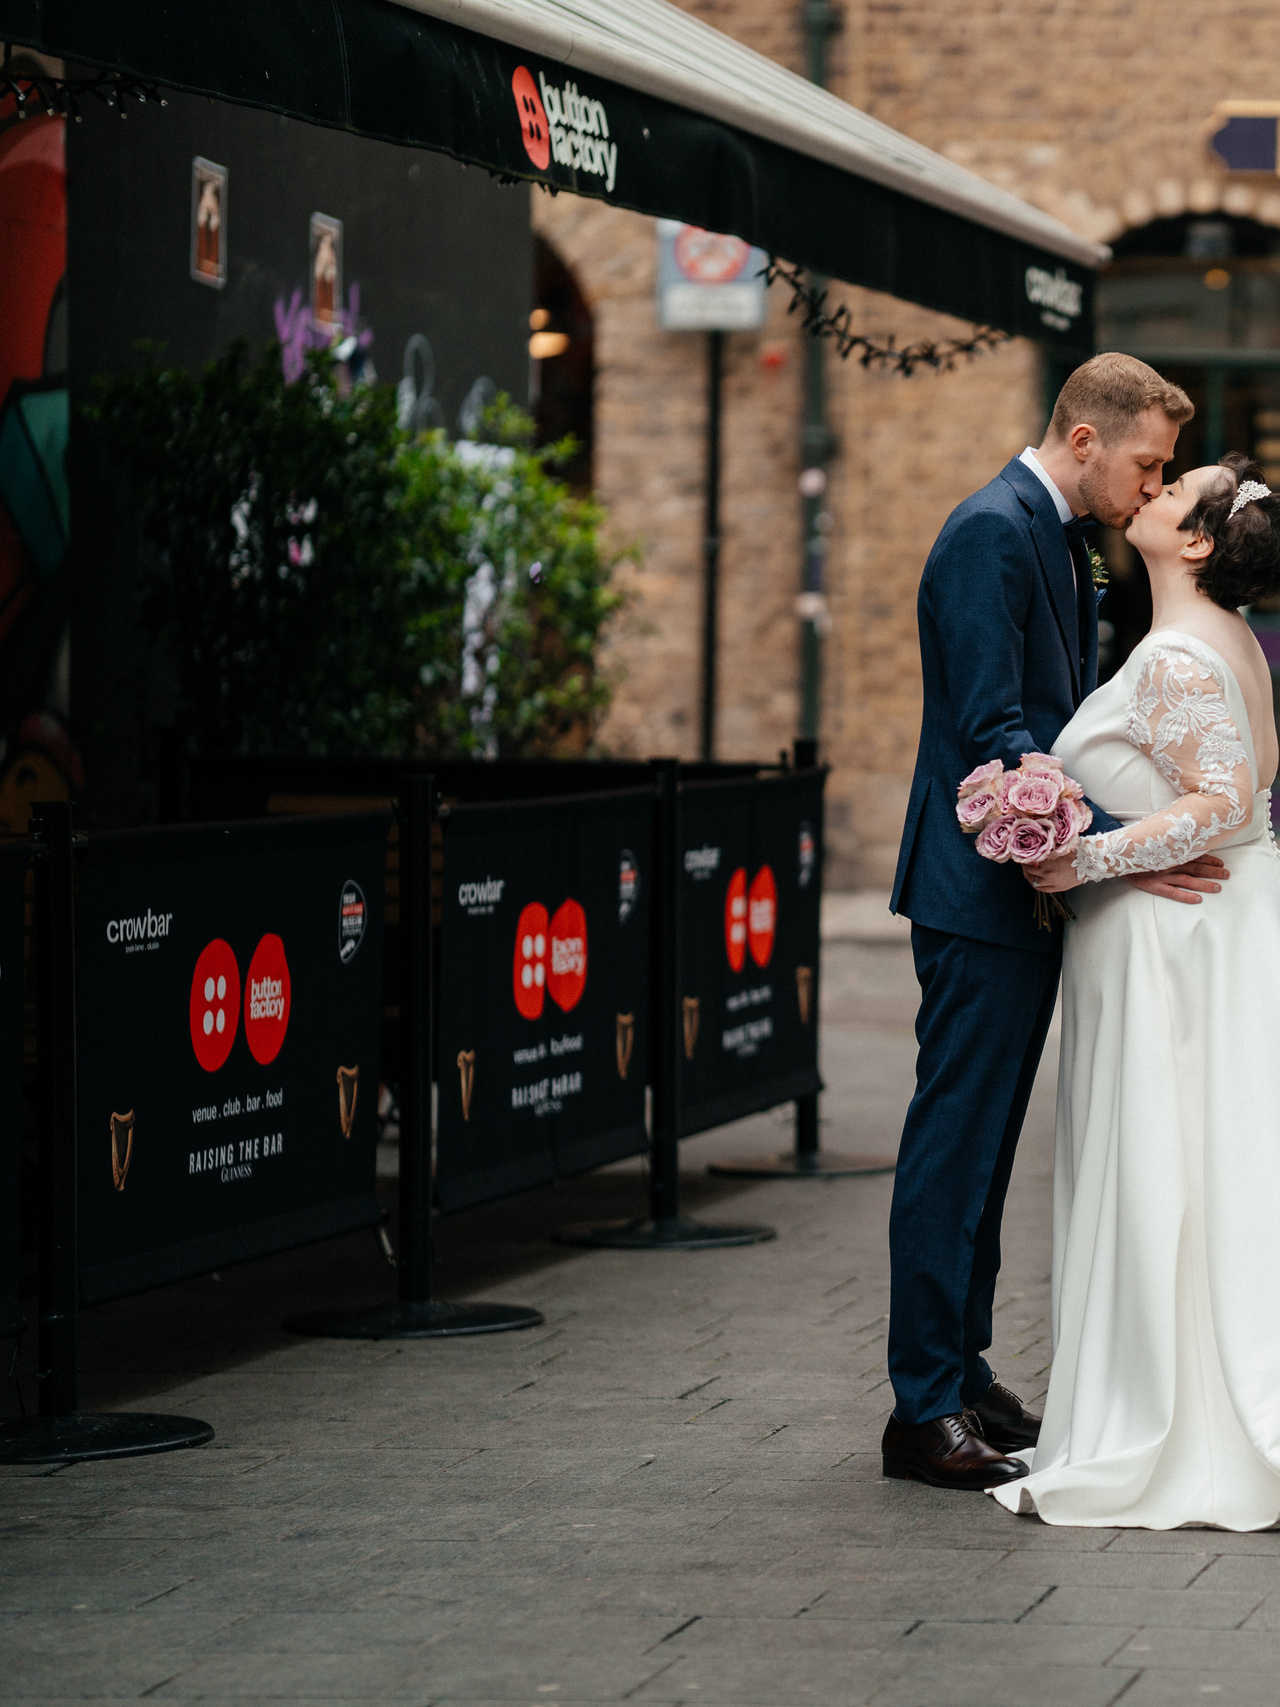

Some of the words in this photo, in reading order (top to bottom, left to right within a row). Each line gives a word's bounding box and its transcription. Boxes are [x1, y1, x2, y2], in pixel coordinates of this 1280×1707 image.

[538, 70, 610, 139] button
[548, 124, 618, 193] factory
[106, 907, 174, 944] crowbar
[250, 975, 283, 1000] button
[249, 995, 286, 1022] factory
[191, 1104, 218, 1124] venue
[222, 1096, 241, 1118] club
[246, 1093, 262, 1112] bar
[265, 1086, 284, 1109] food
[188, 1142, 235, 1175] RAISING
[238, 1137, 261, 1162] THE
[262, 1131, 284, 1158] BAR
[220, 1162, 253, 1184] GUINNESS
